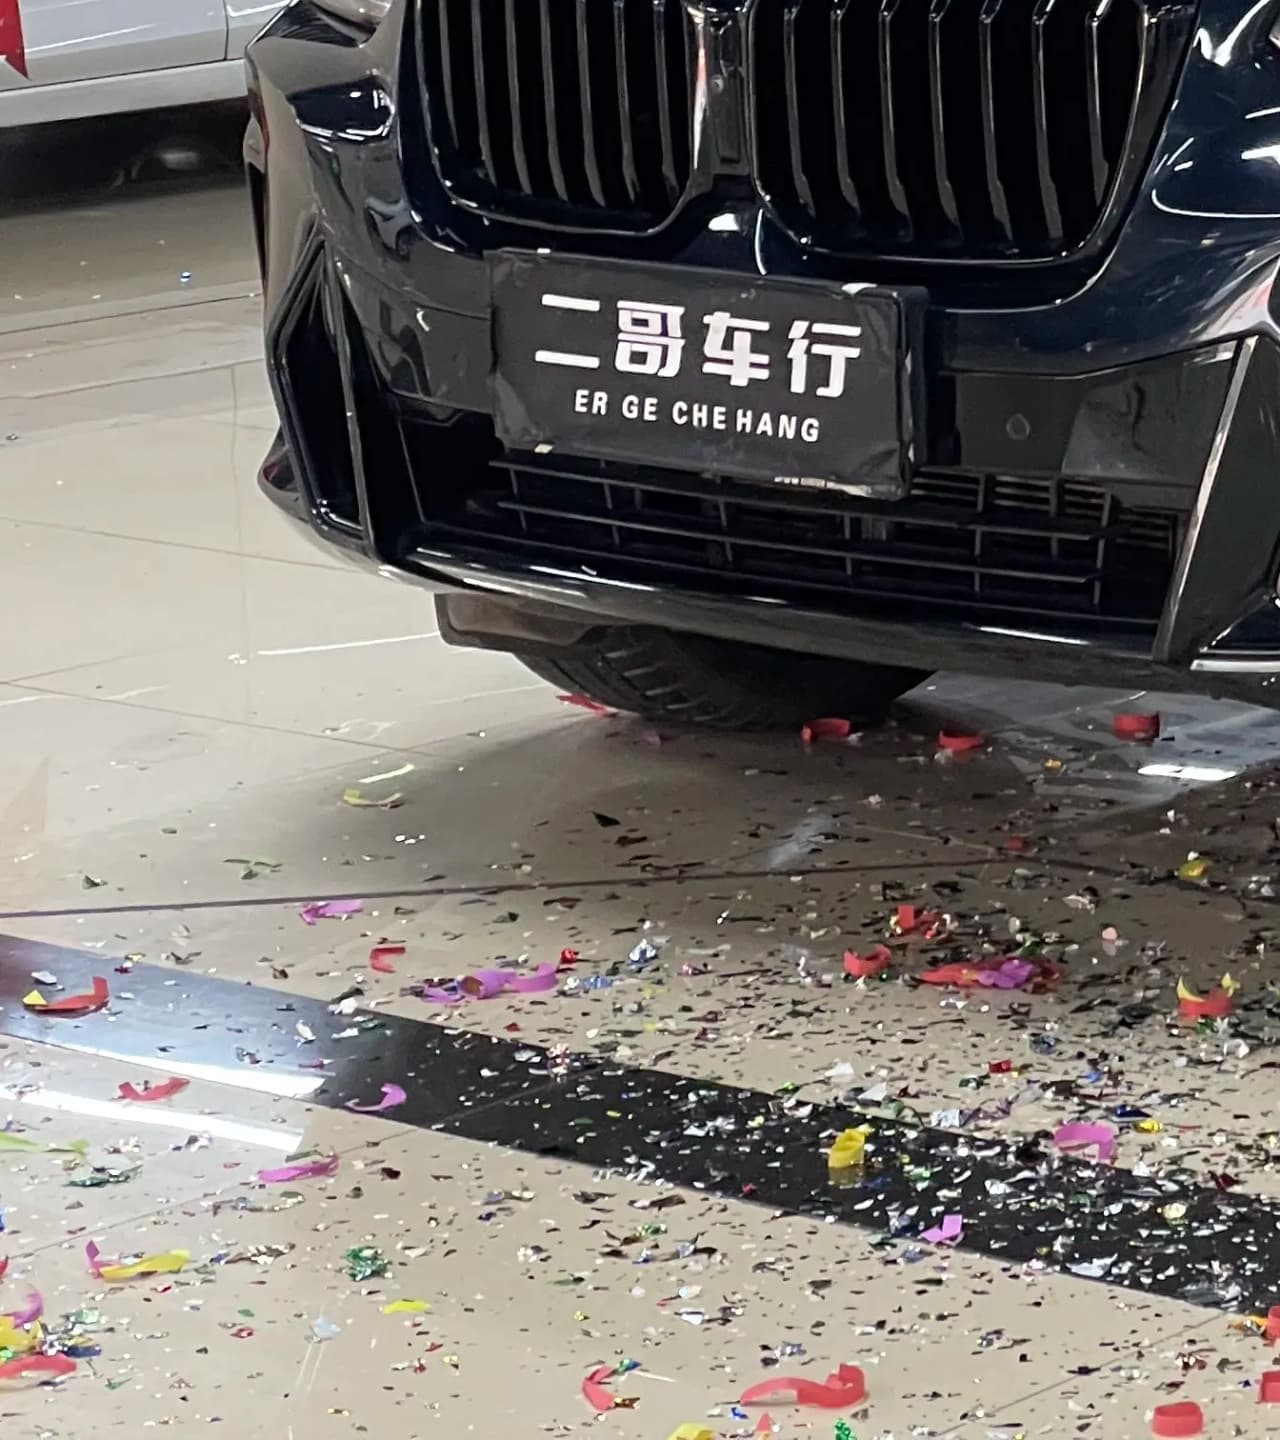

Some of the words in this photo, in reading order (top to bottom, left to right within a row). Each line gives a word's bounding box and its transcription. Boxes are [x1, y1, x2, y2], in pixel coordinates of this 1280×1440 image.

[534, 293, 862, 398] 二哥车行
[574, 388, 608, 416] ER
[621, 394, 659, 421] GE
[672, 400, 727, 430] CHE
[736, 408, 820, 442] HANG
